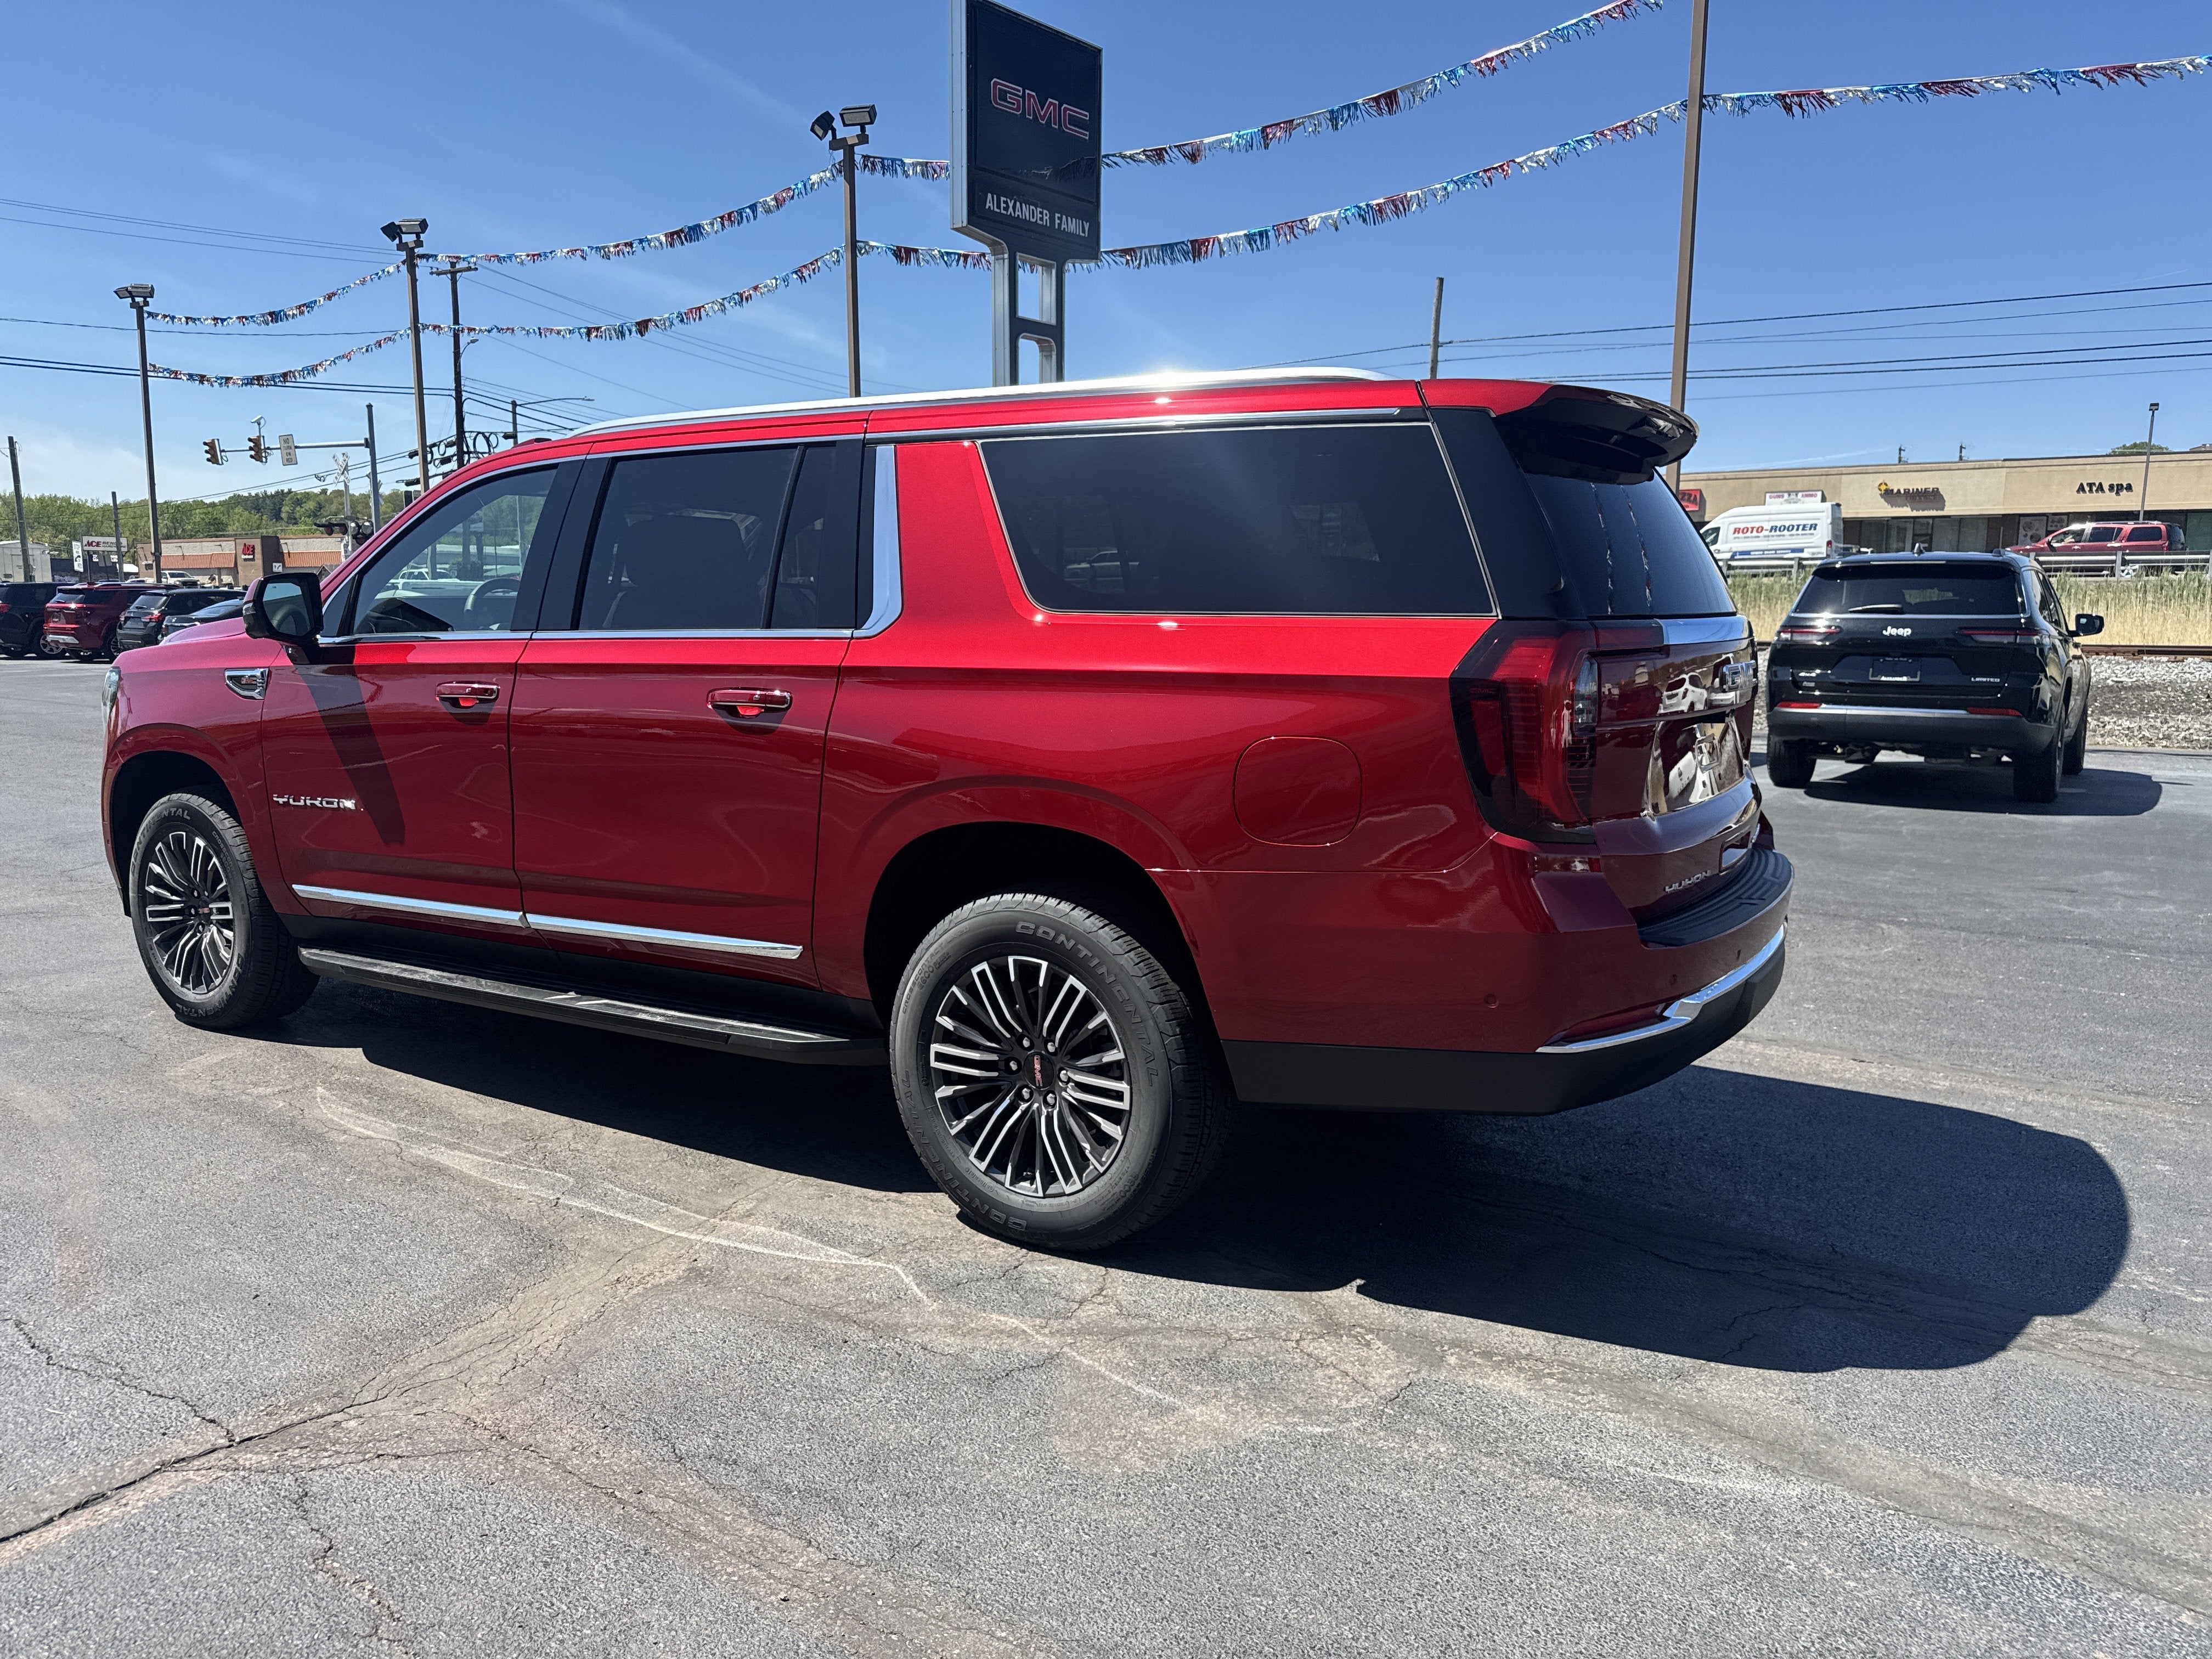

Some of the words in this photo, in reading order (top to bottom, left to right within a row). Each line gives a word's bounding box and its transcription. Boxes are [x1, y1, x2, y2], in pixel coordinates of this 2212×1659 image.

[991, 77, 1089, 140] GMC
[986, 193, 1050, 227] ALEXANDER
[1055, 213, 1090, 238] FAMILY
[1883, 487, 1940, 495] MARINER
[2076, 482, 2106, 494] ATA
[2108, 483, 2133, 496] spa
[1679, 492, 1698, 505] ZZA
[1733, 523, 1818, 535] ROTO-ROOTER
[242, 543, 255, 554] ACE
[1882, 626, 1911, 636] Jeep
[273, 794, 356, 810] YUKON
[1664, 870, 1712, 894] YUKON
[1034, 1055, 1043, 1087] GMC
